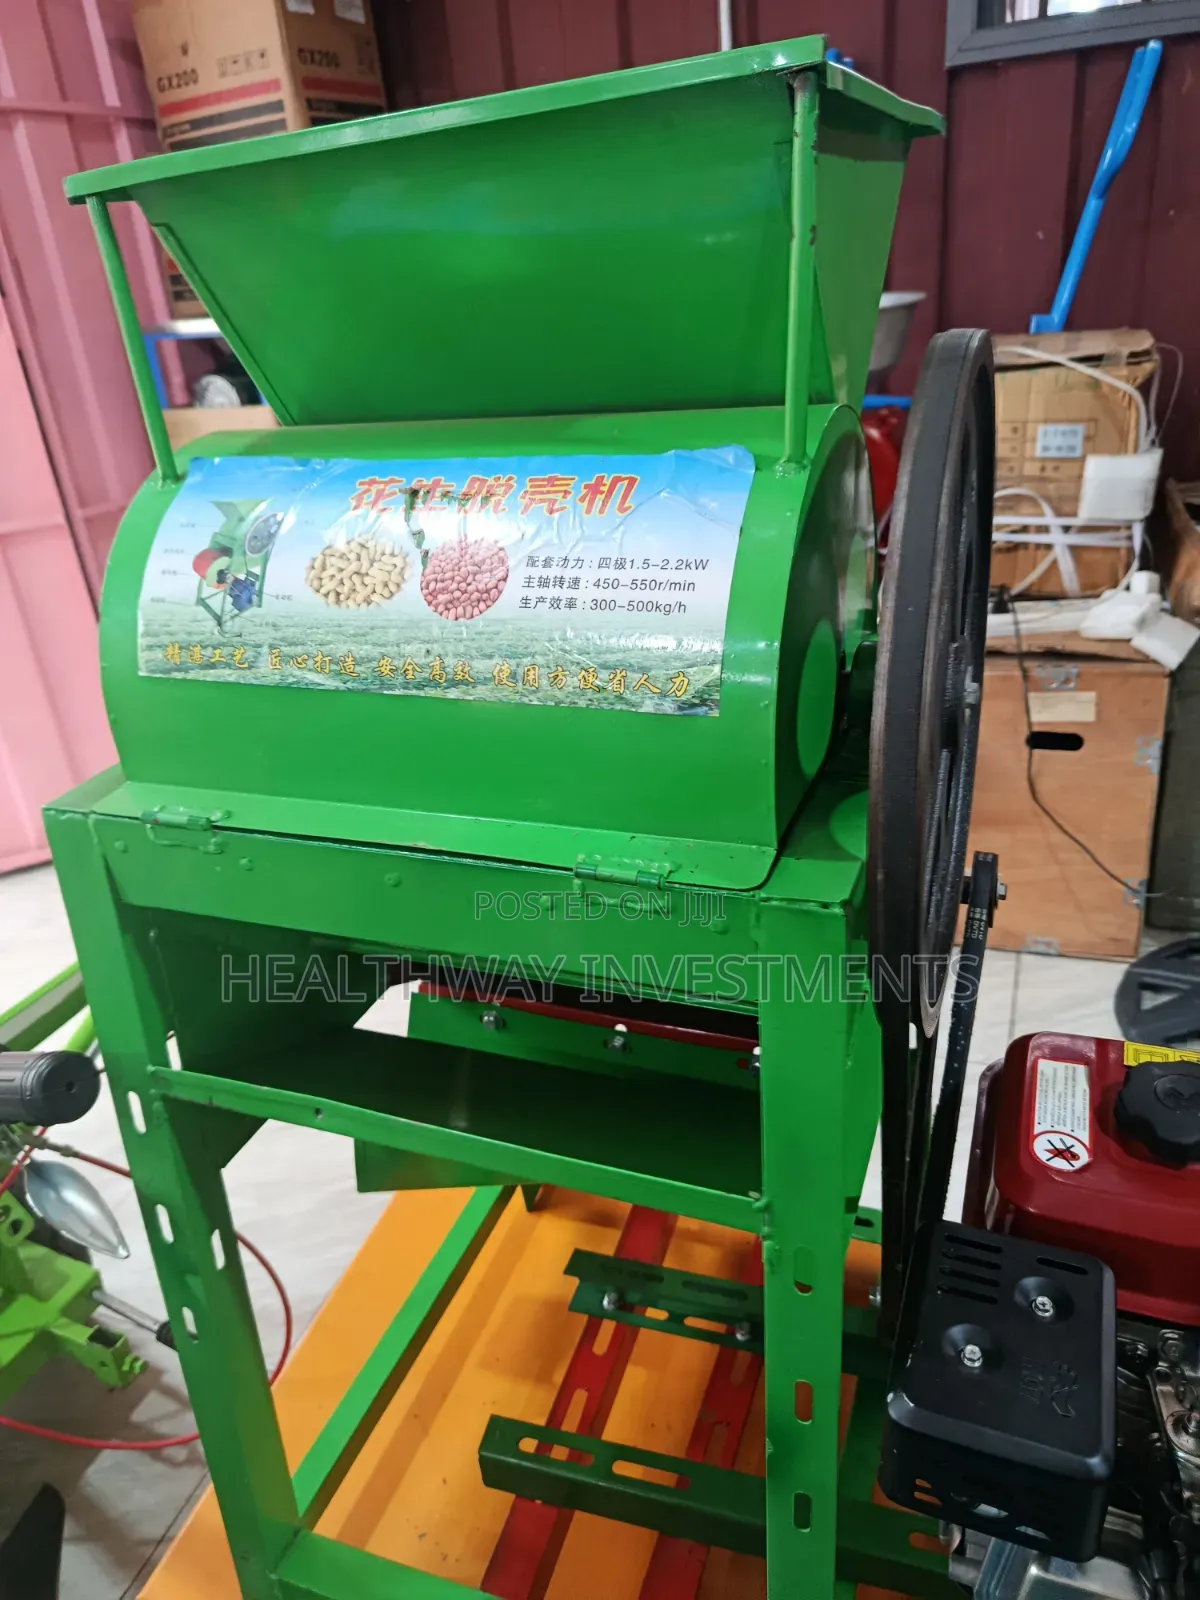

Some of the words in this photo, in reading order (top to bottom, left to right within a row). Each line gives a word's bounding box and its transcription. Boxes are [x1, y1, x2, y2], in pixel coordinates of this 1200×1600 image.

[157, 68, 199, 93] GX200
[350, 473, 640, 516] 花生脱壳机
[266, 648, 360, 678] 匠心打造
[373, 655, 475, 685] 安全高效
[492, 659, 691, 698] 使用方便省人力
